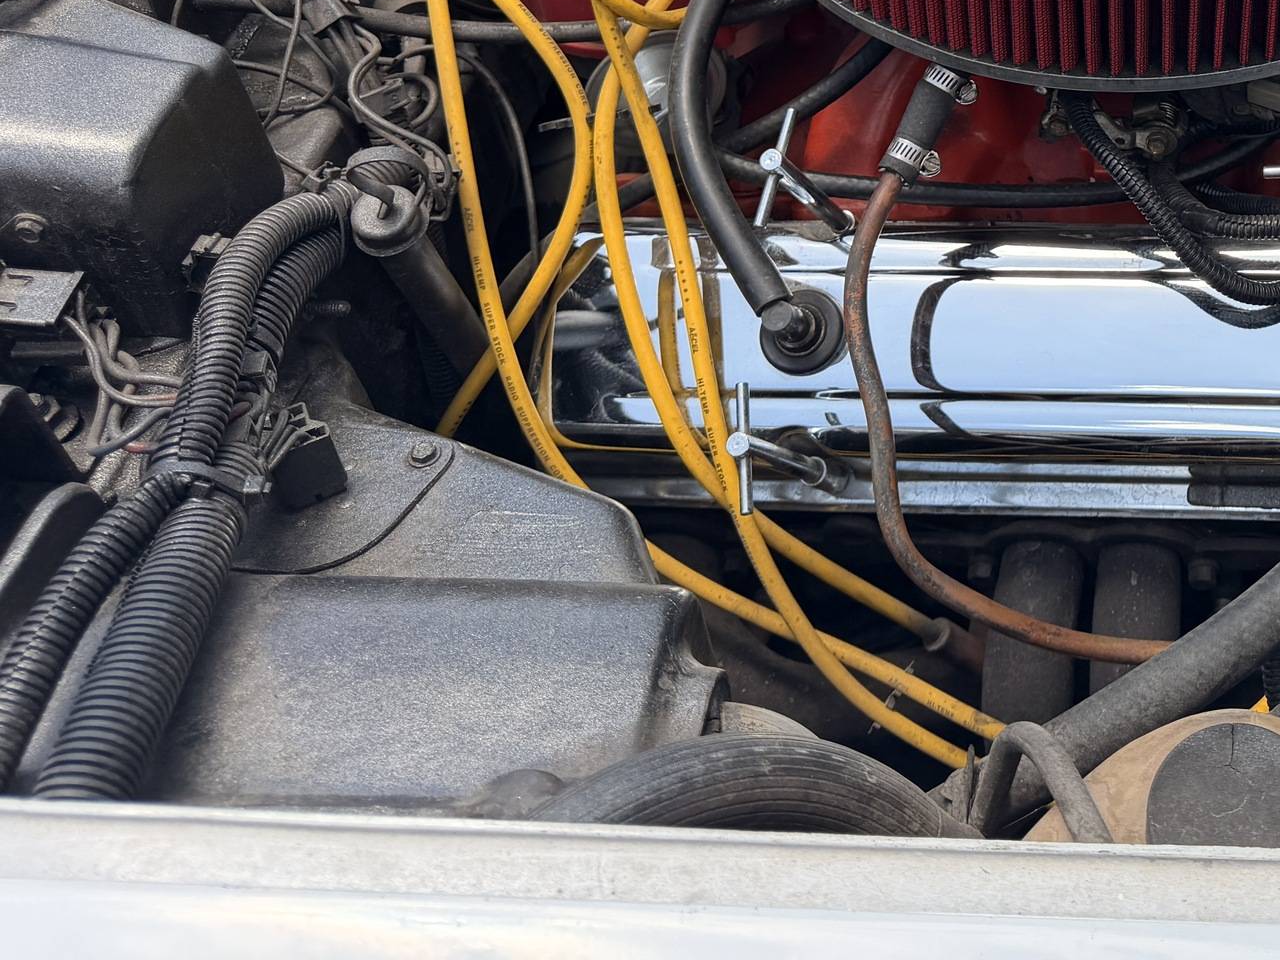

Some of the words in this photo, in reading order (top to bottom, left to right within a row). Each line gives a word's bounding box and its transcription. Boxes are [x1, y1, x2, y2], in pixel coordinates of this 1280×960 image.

[483, 302, 497, 331] SUPER
[492, 335, 506, 366] STOCK
[504, 374, 521, 402] RADIO
[516, 405, 552, 463] SUPPRESSION
[707, 427, 718, 457] SUPER
[716, 463, 728, 492] STOCK
